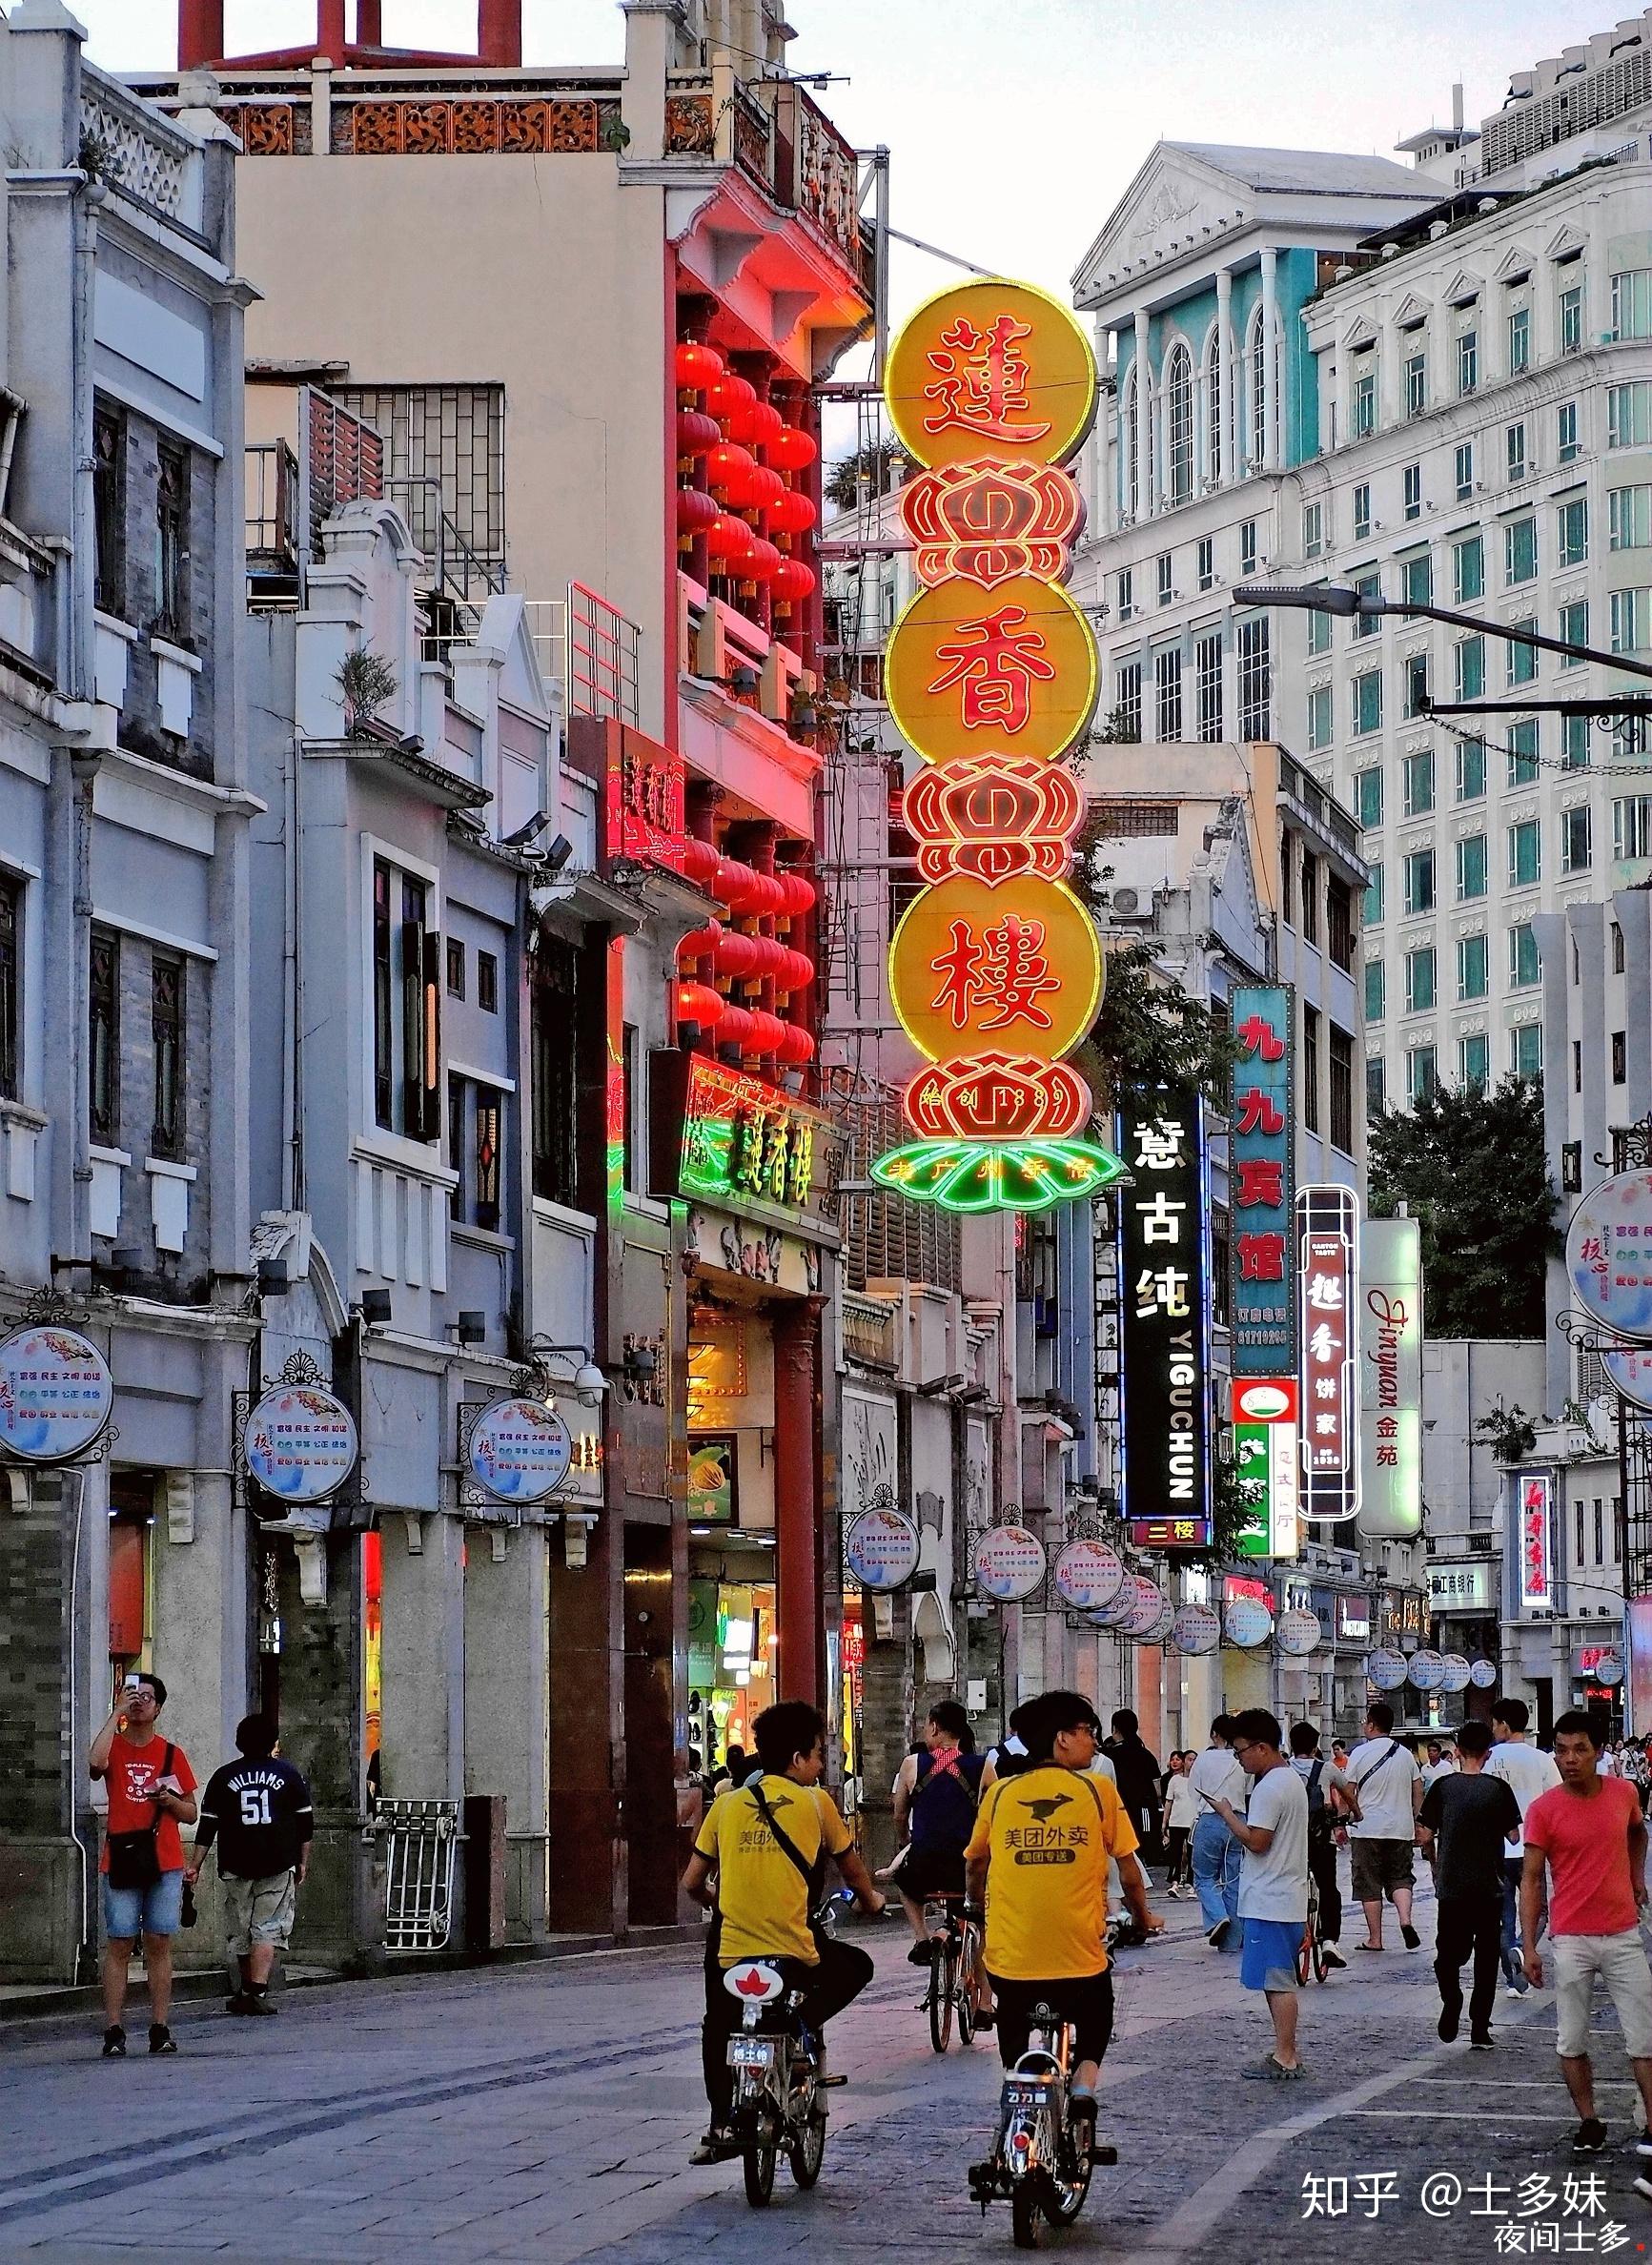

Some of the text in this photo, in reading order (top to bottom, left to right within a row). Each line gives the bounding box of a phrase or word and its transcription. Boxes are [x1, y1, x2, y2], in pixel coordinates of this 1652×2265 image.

[1235, 1014, 1286, 1281] 九九宾馆
[1133, 1117, 1191, 1317] 意古纯
[1581, 1237, 1609, 1274] 核心
[1306, 1273, 1343, 1435] 趣香饼家
[1367, 1289, 1409, 1408] Jinyuan
[1170, 1330, 1194, 1499] YIGUCHUN
[1377, 1416, 1398, 1467] 金苑
[1148, 1520, 1194, 1540] 二楼
[227, 1771, 285, 1792] WILLIAMS
[241, 1789, 272, 1826] 51
[1005, 1826, 1089, 1849] 美团外卖
[1021, 1851, 1068, 1863] 美团专送
